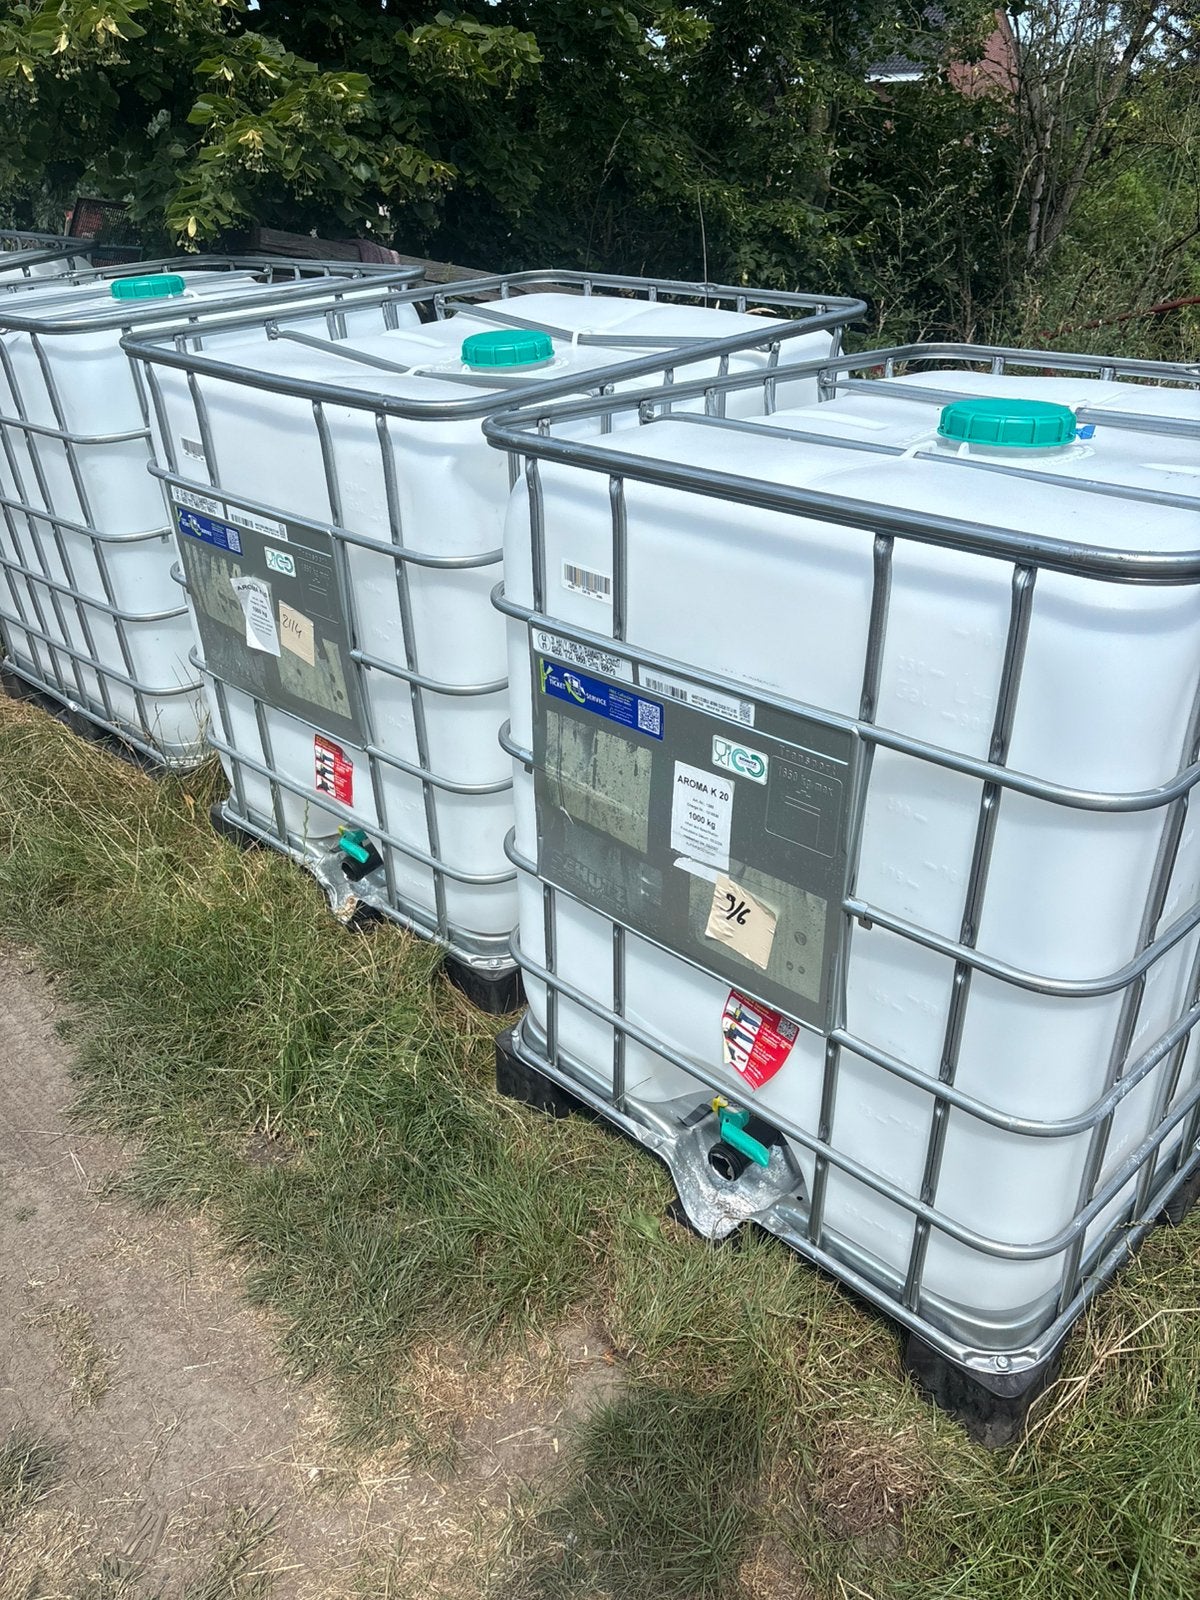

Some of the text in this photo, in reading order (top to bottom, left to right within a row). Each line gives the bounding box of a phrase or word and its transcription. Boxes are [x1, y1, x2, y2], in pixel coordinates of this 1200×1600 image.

[677, 775, 729, 802] AROMA K 20
[688, 811, 706, 825] 1000
[706, 818, 716, 831] kg
[722, 893, 751, 926] 9/6
